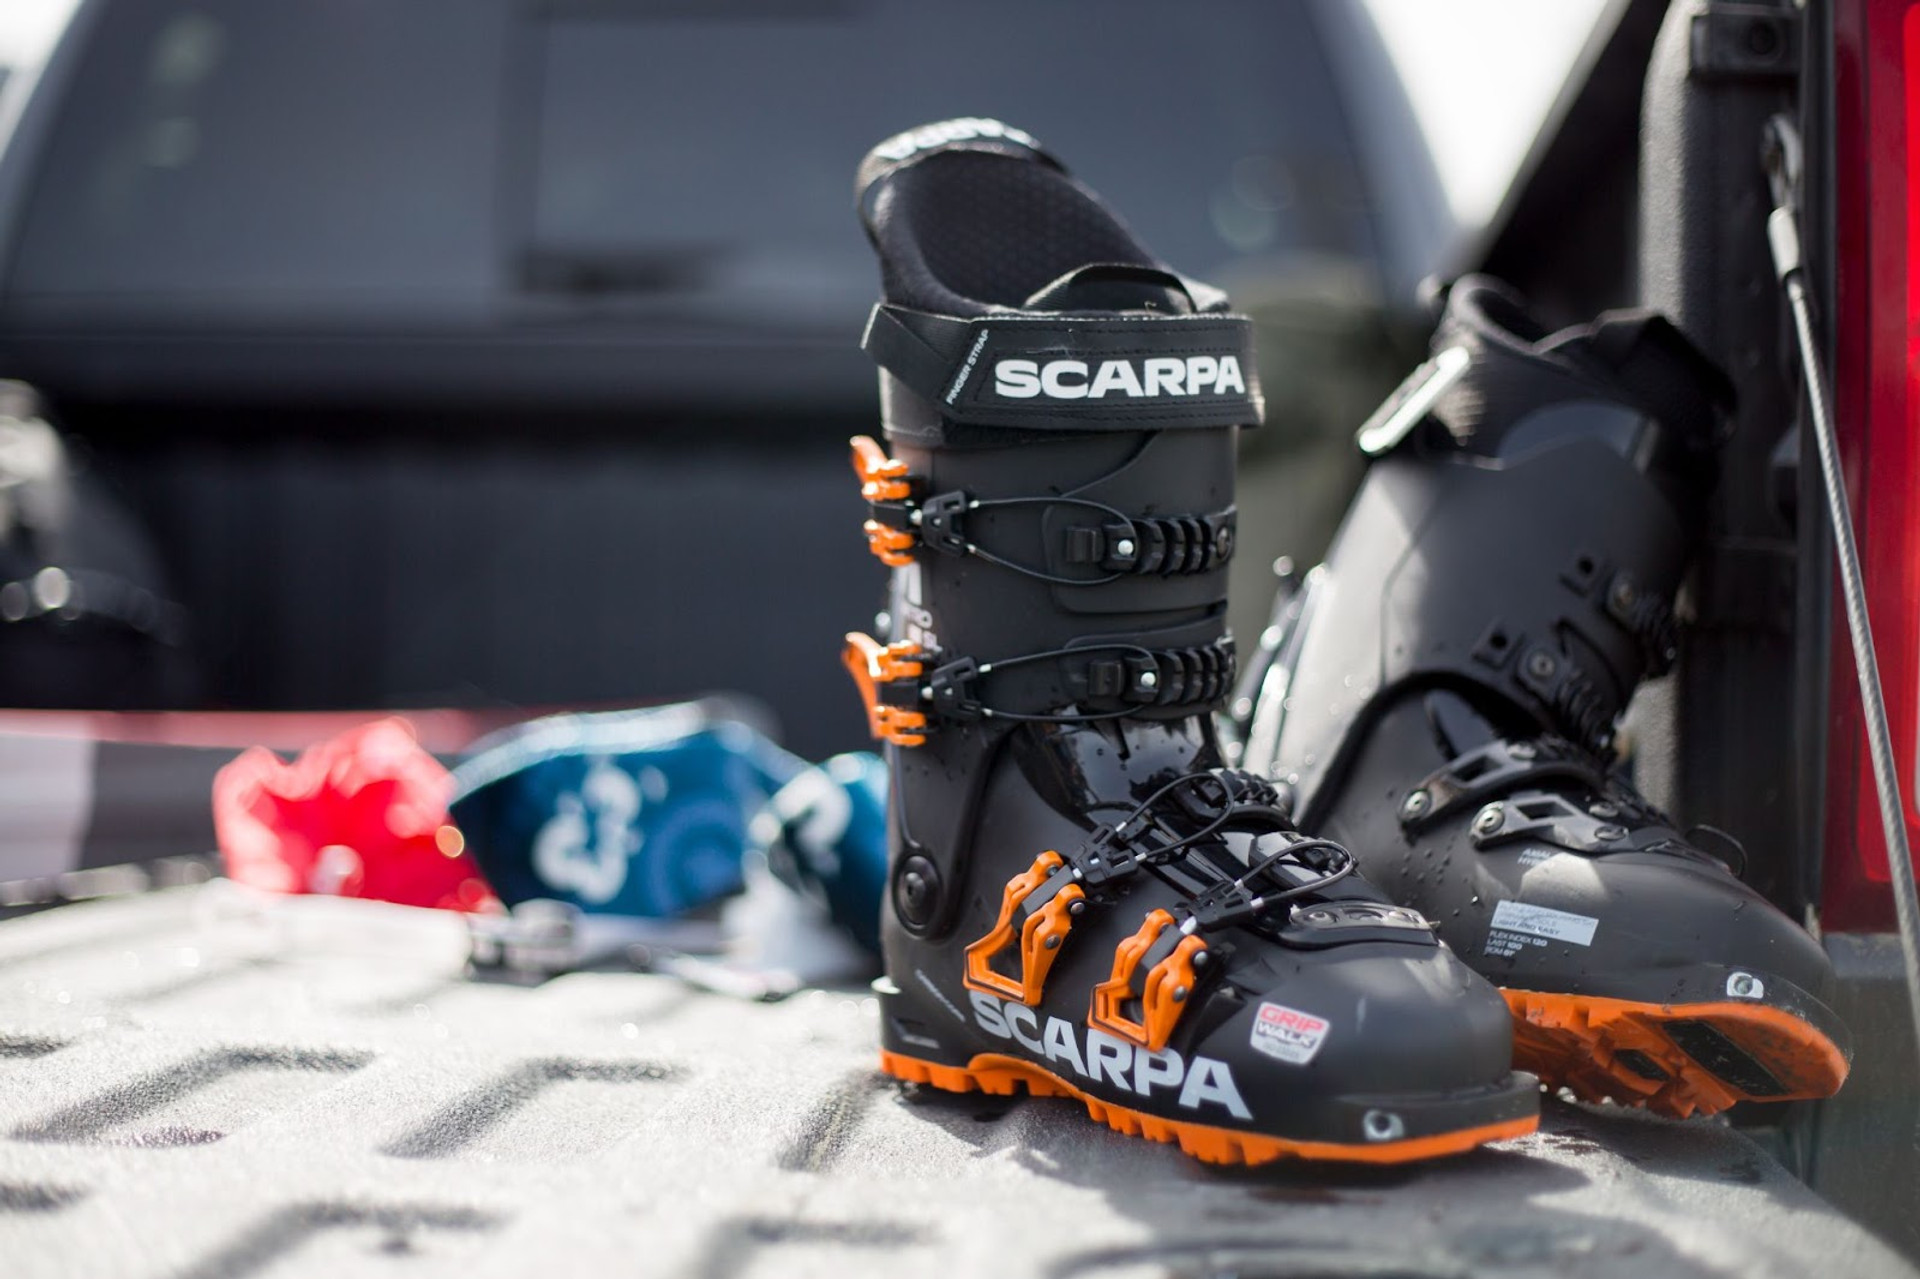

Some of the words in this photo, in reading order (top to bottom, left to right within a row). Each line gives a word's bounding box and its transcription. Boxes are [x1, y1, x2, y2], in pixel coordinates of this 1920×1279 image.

[945, 364, 972, 405] FINGER
[967, 329, 989, 366] STRAP
[995, 356, 1245, 399] SCARPA
[1257, 1021, 1317, 1048] WALK
[1260, 1005, 1324, 1032] GRIP
[969, 990, 1253, 1121] SCARPA
